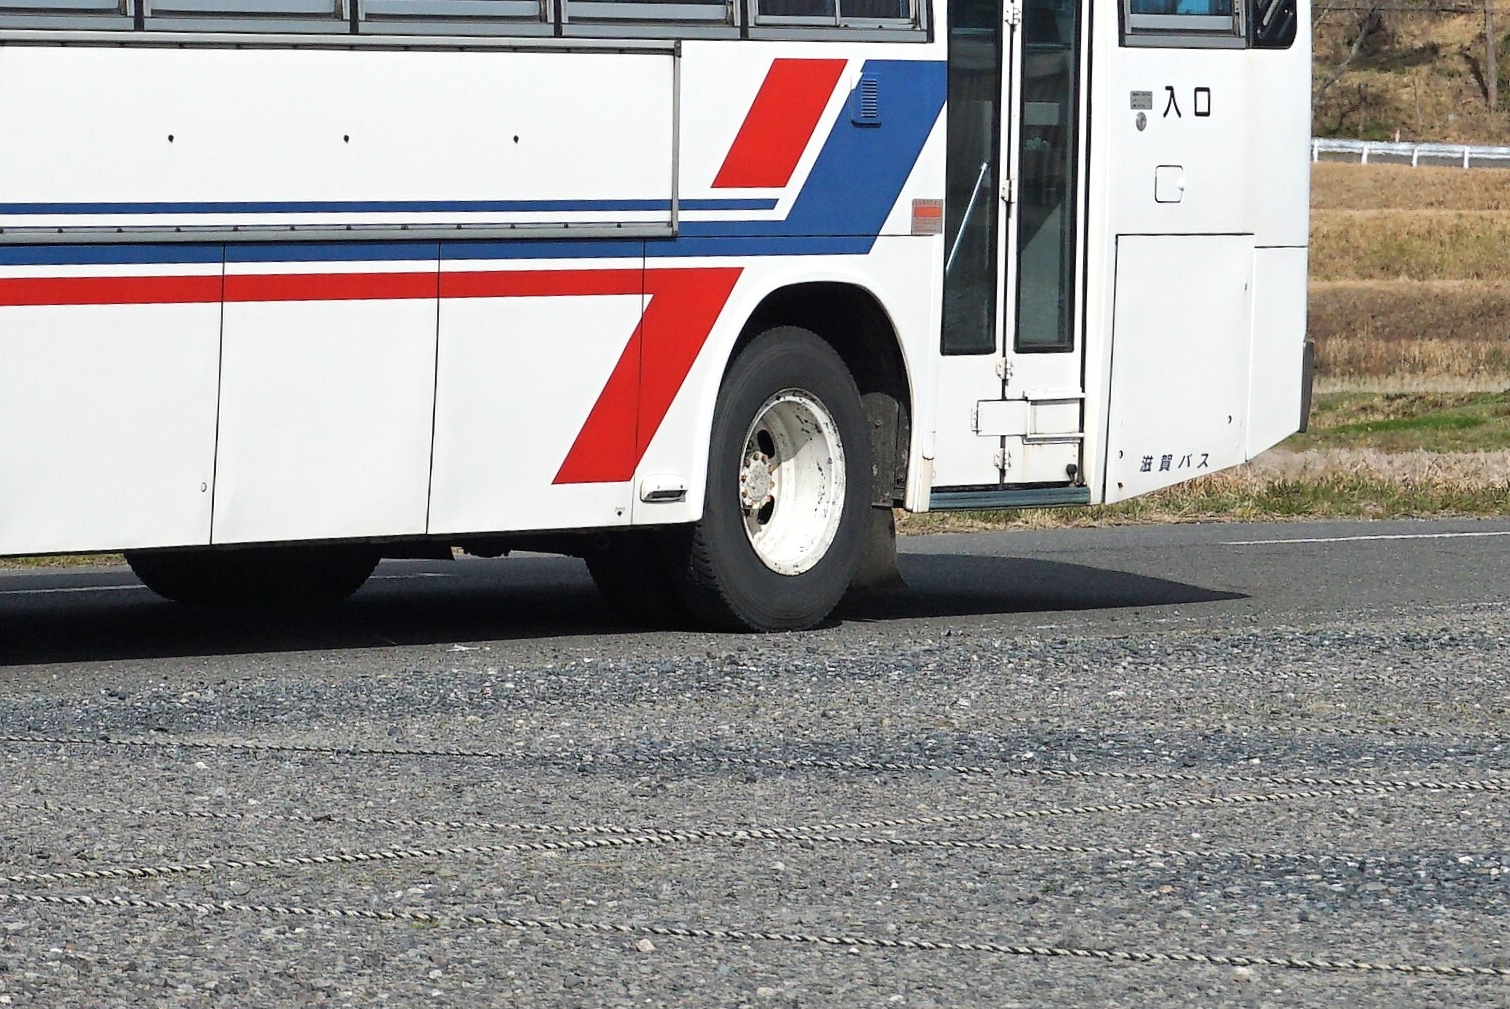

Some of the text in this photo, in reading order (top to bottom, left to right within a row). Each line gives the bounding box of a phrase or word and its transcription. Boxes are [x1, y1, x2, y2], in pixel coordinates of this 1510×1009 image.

[1163, 85, 1211, 118] 入口
[1139, 453, 1209, 472] 滋賀バス
